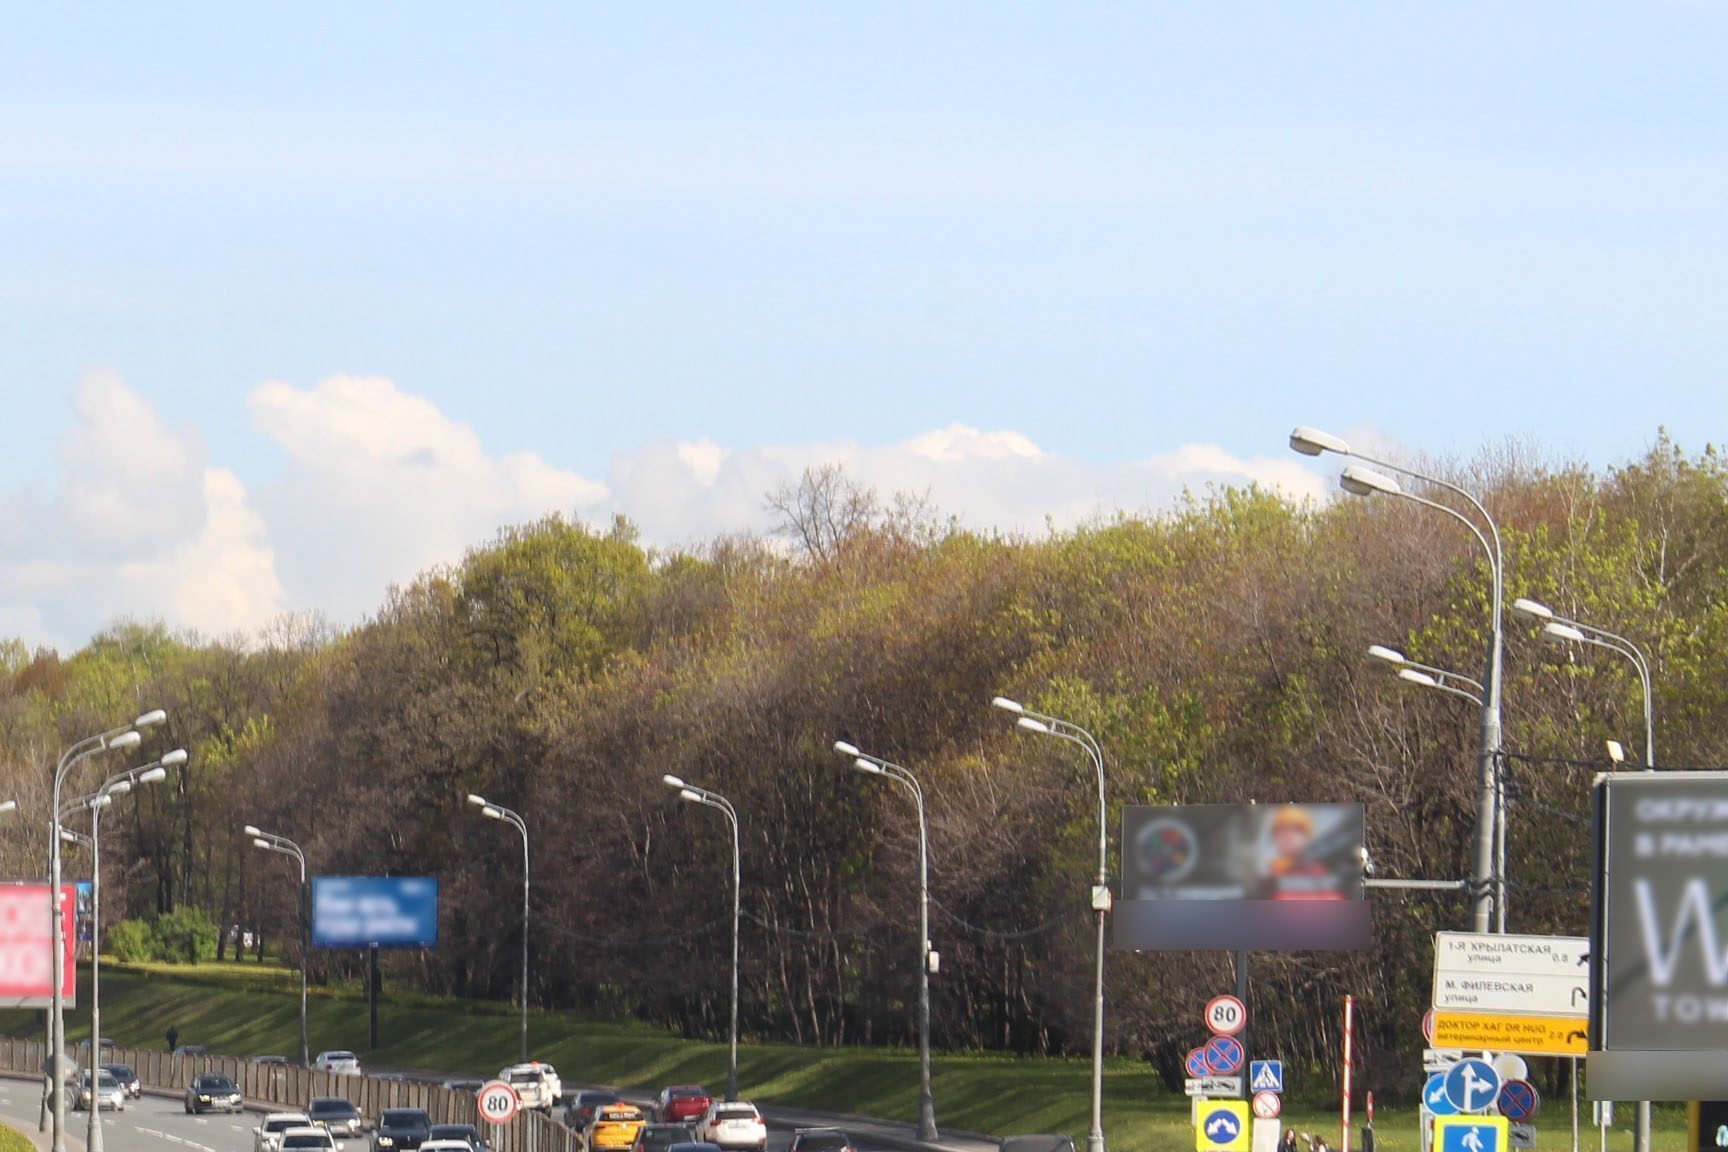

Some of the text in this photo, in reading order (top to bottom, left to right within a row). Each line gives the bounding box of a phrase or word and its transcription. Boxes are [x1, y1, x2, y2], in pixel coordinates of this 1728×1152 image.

[1471, 941, 1552, 955] КРЫЛАТСКАЯ
[1467, 953, 1503, 964] улица
[1460, 979, 1535, 993] ФИЛЕВСКАЯ
[1443, 993, 1479, 1005] улица
[1214, 1005, 1236, 1022] 80
[487, 1095, 508, 1111] 80
